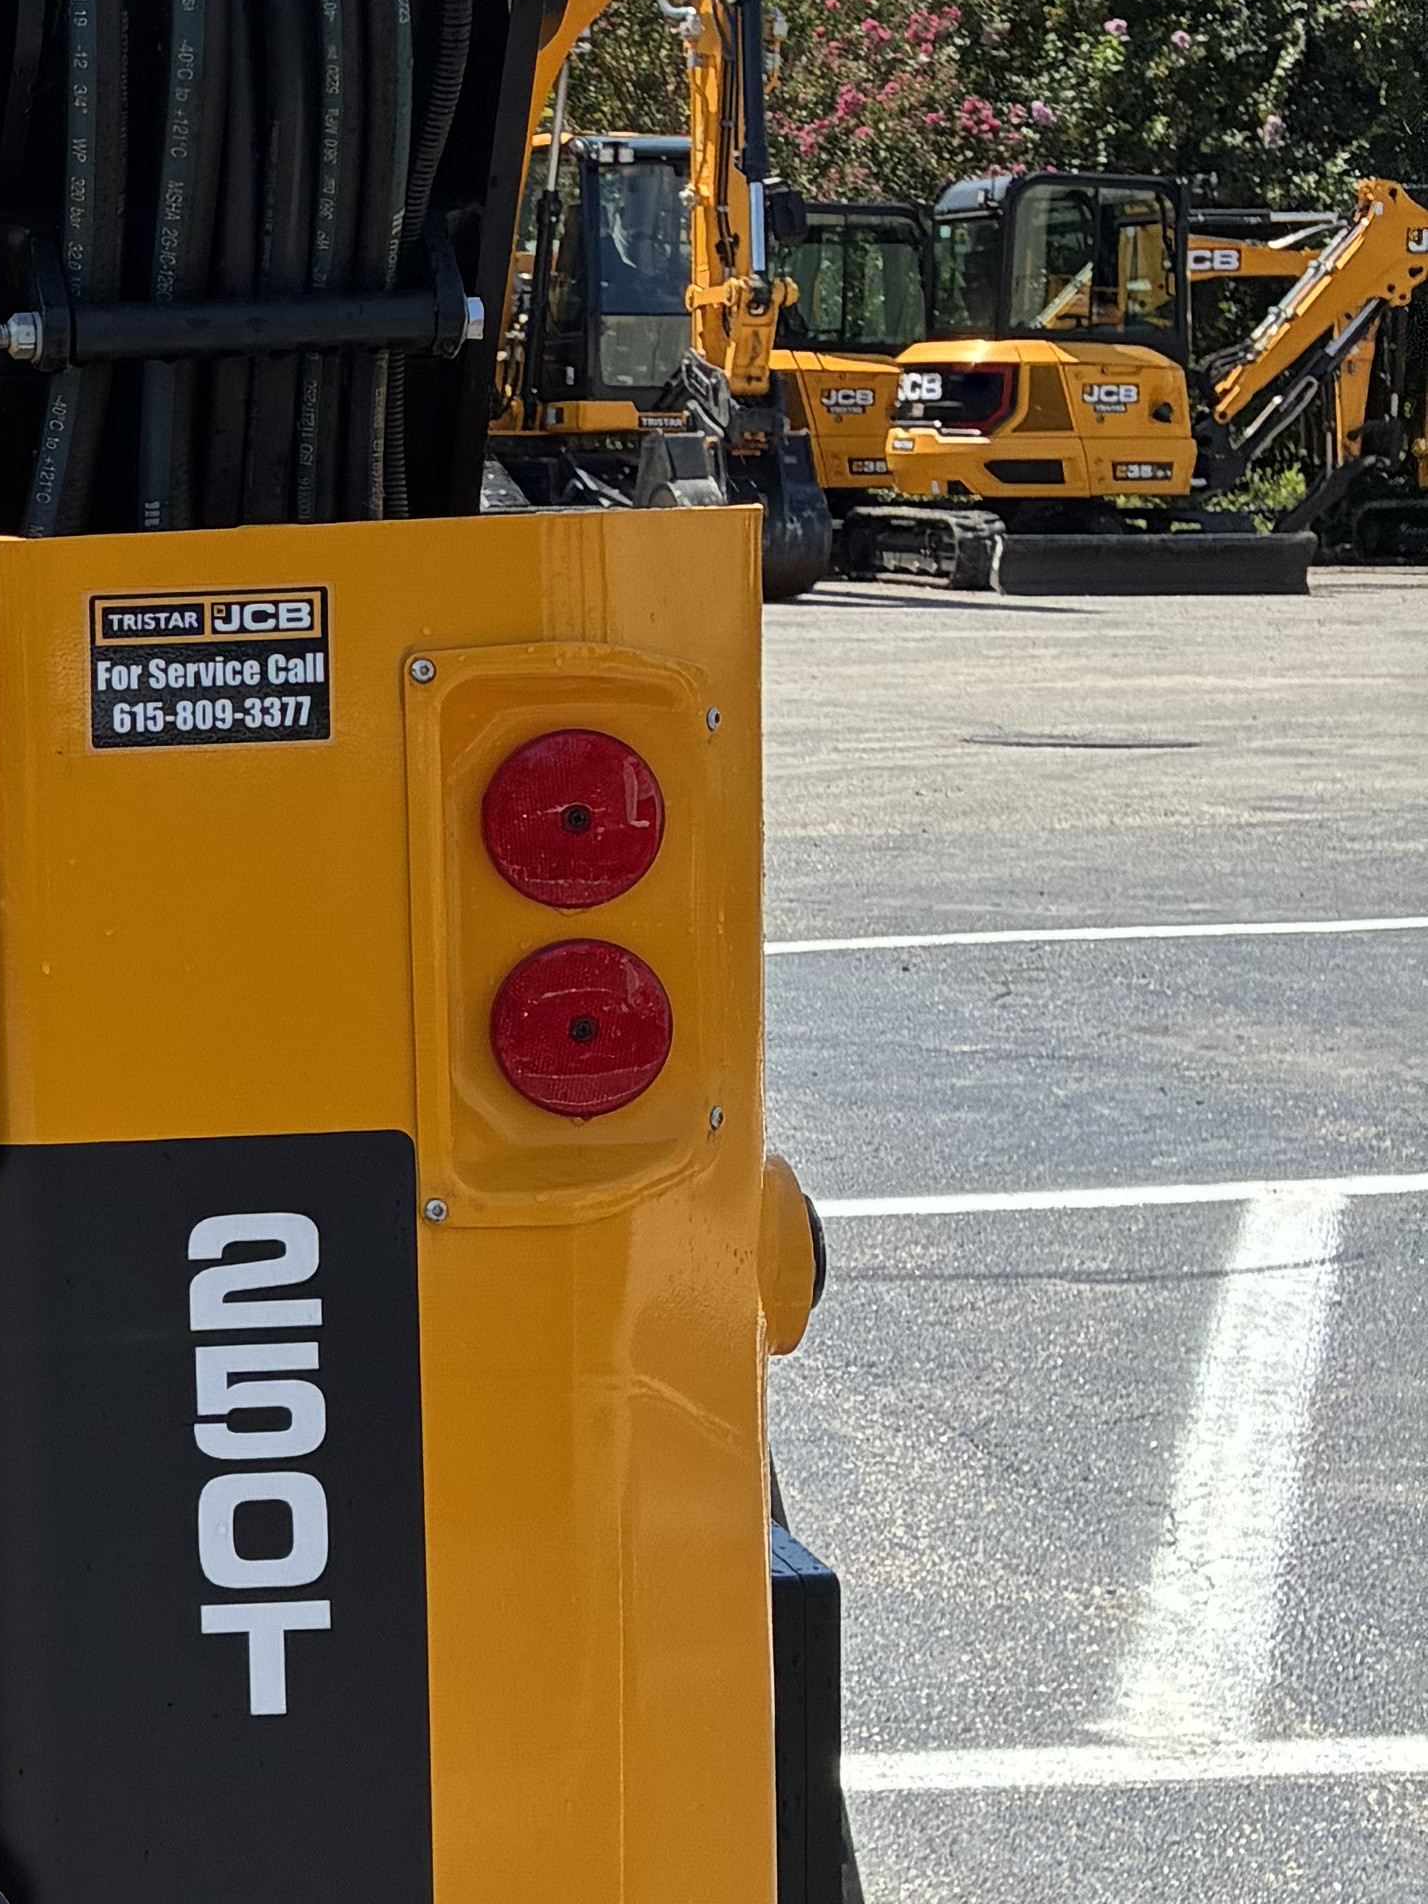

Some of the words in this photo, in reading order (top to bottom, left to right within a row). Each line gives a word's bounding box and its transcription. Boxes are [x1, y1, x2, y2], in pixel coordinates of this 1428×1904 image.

[72, 8, 88, 28] 19
[70, 137, 88, 164] WP
[70, 175, 87, 202] 320
[164, 179, 185, 221] MSHA
[69, 206, 85, 230] bar
[821, 389, 874, 406] JCB
[1083, 384, 1139, 402] JCB
[108, 611, 199, 631] TRISTAR
[214, 602, 312, 633] JCB
[96, 660, 143, 691] For
[149, 656, 260, 689] Service
[268, 652, 325, 685] Call
[112, 695, 311, 734] 615-809-3377
[187, 1211, 331, 1716] 250T
